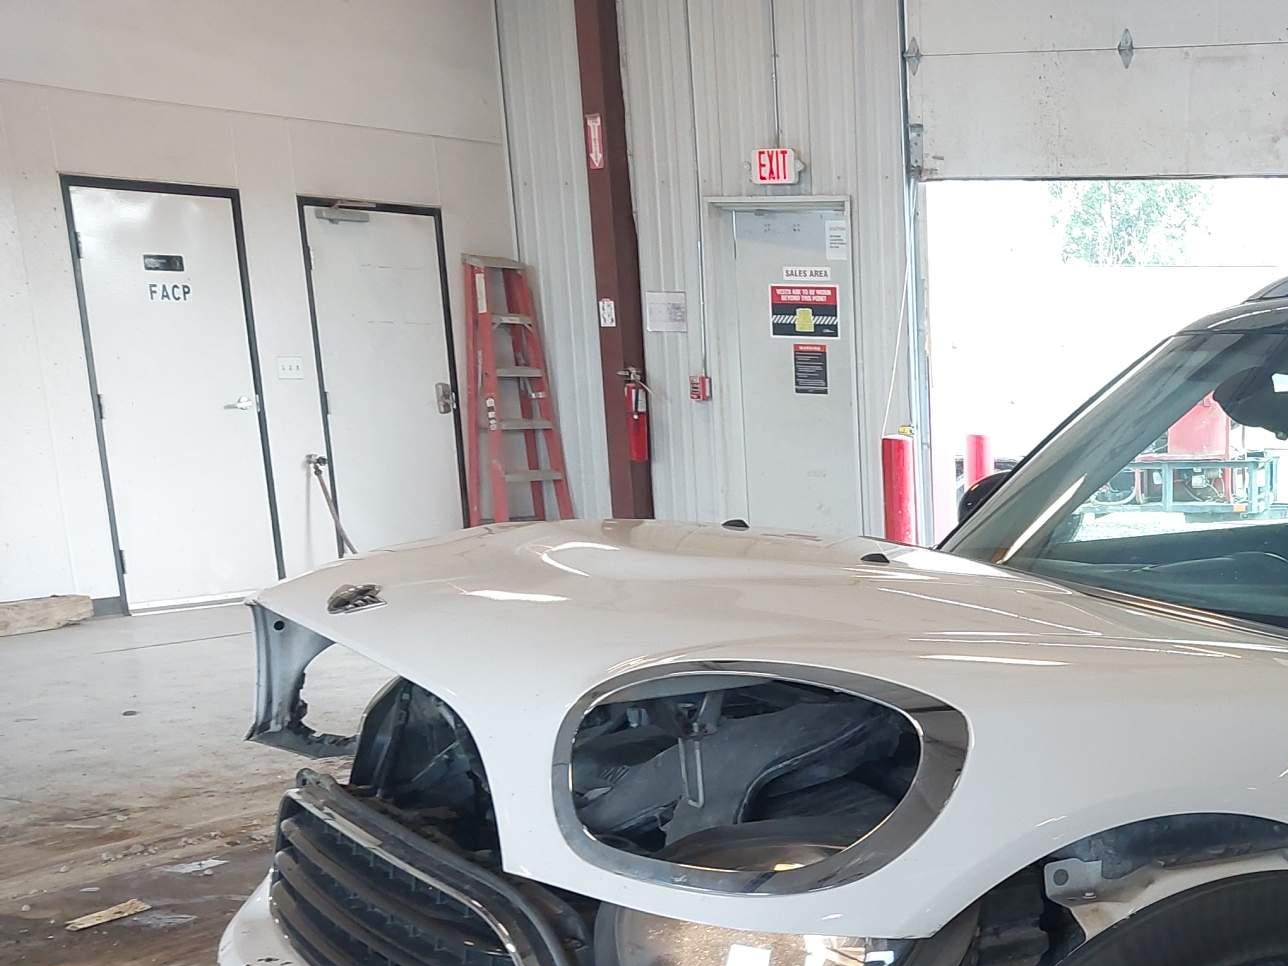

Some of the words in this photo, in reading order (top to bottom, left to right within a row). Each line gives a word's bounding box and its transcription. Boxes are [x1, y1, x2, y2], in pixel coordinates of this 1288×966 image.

[758, 150, 788, 180] EXIT
[785, 269, 808, 278] SALES
[809, 270, 829, 278] AREA
[149, 283, 191, 301] FACP
